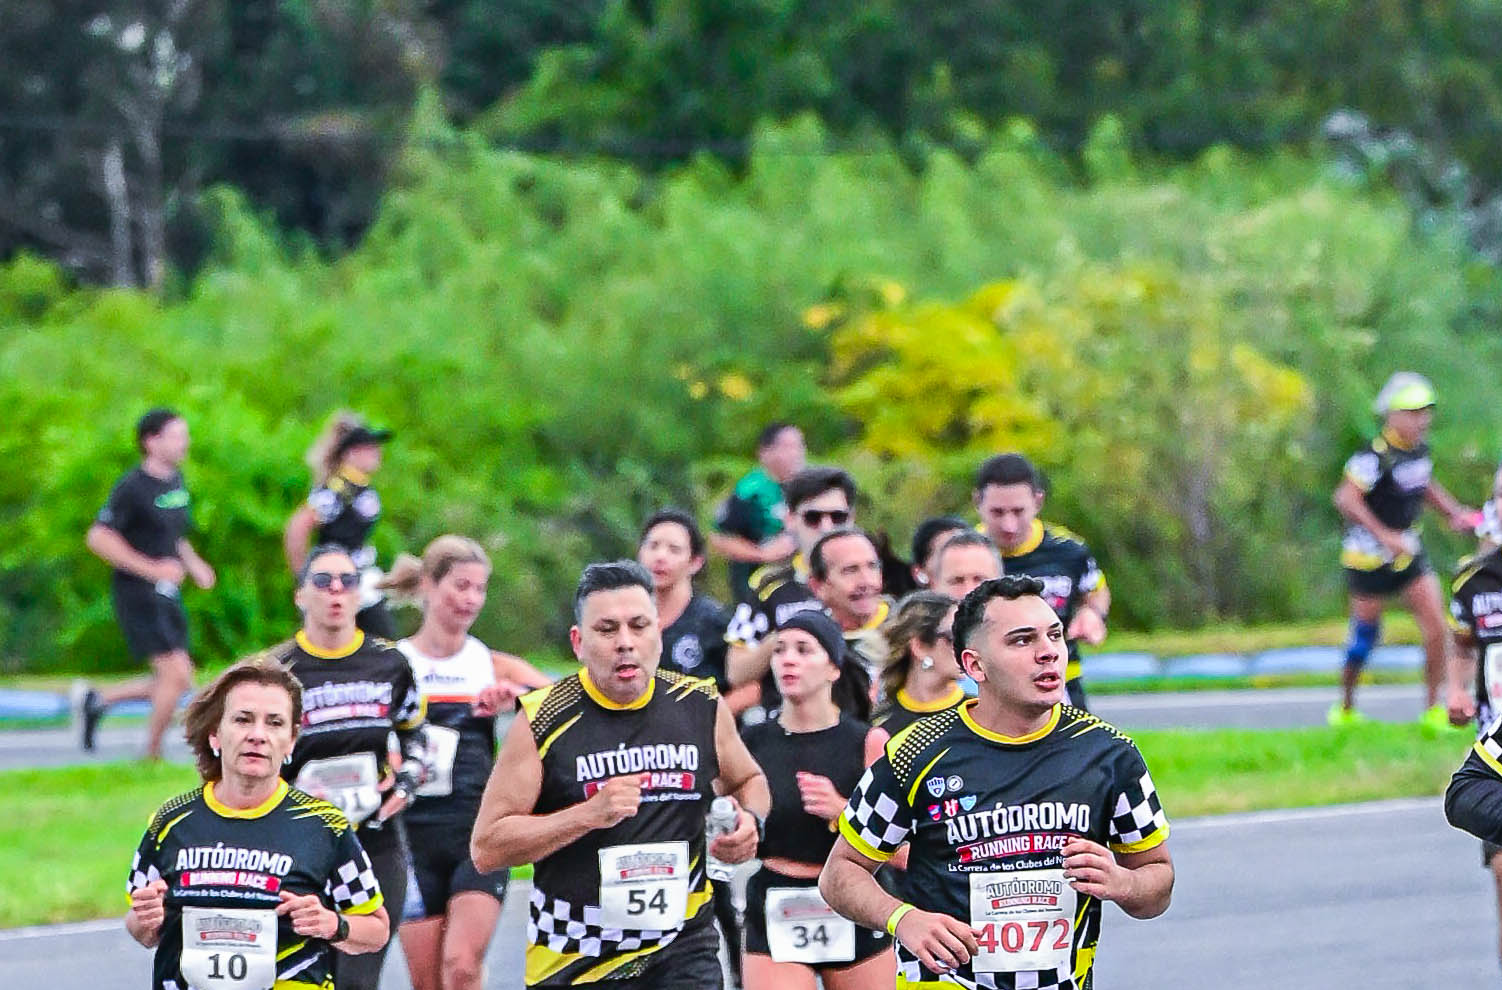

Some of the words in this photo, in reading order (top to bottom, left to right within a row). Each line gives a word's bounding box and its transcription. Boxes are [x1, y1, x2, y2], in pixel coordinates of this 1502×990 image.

[576, 743, 699, 782] AUTÓDROMO
[651, 772, 683, 788] RACE
[945, 802, 1091, 845] AUTÓDROMO
[175, 842, 293, 876] AUTÓDROMO
[971, 836, 1031, 860] RUNNING
[1034, 835, 1068, 851] RACE
[948, 863, 957, 872] La
[958, 864, 988, 872] Carrera
[990, 863, 1001, 871] de
[1002, 863, 1015, 871] los
[1016, 860, 1042, 870] Clubes
[1044, 857, 1055, 866] del
[627, 888, 668, 916] 54
[986, 877, 1063, 899] AUTÓDROMO
[792, 925, 829, 948] 34
[977, 919, 1070, 954] 4072
[208, 953, 247, 981] 10
